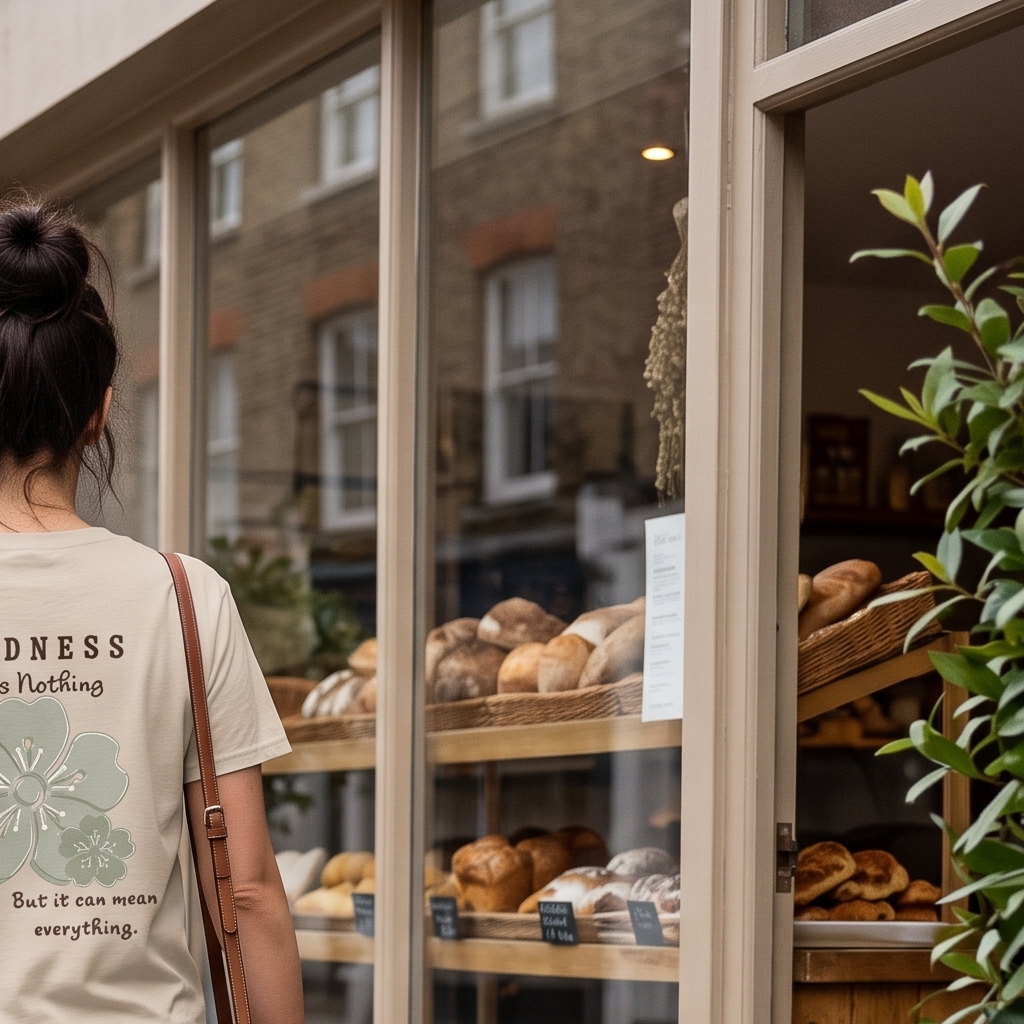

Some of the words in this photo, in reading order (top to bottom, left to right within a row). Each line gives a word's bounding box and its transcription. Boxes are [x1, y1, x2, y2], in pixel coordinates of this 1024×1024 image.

[17, 670, 104, 697] Nothing
[12, 891, 48, 909] But
[54, 893, 69, 908] it
[75, 895, 106, 907] can
[112, 894, 158, 906] mean
[34, 917, 138, 941] everything.
